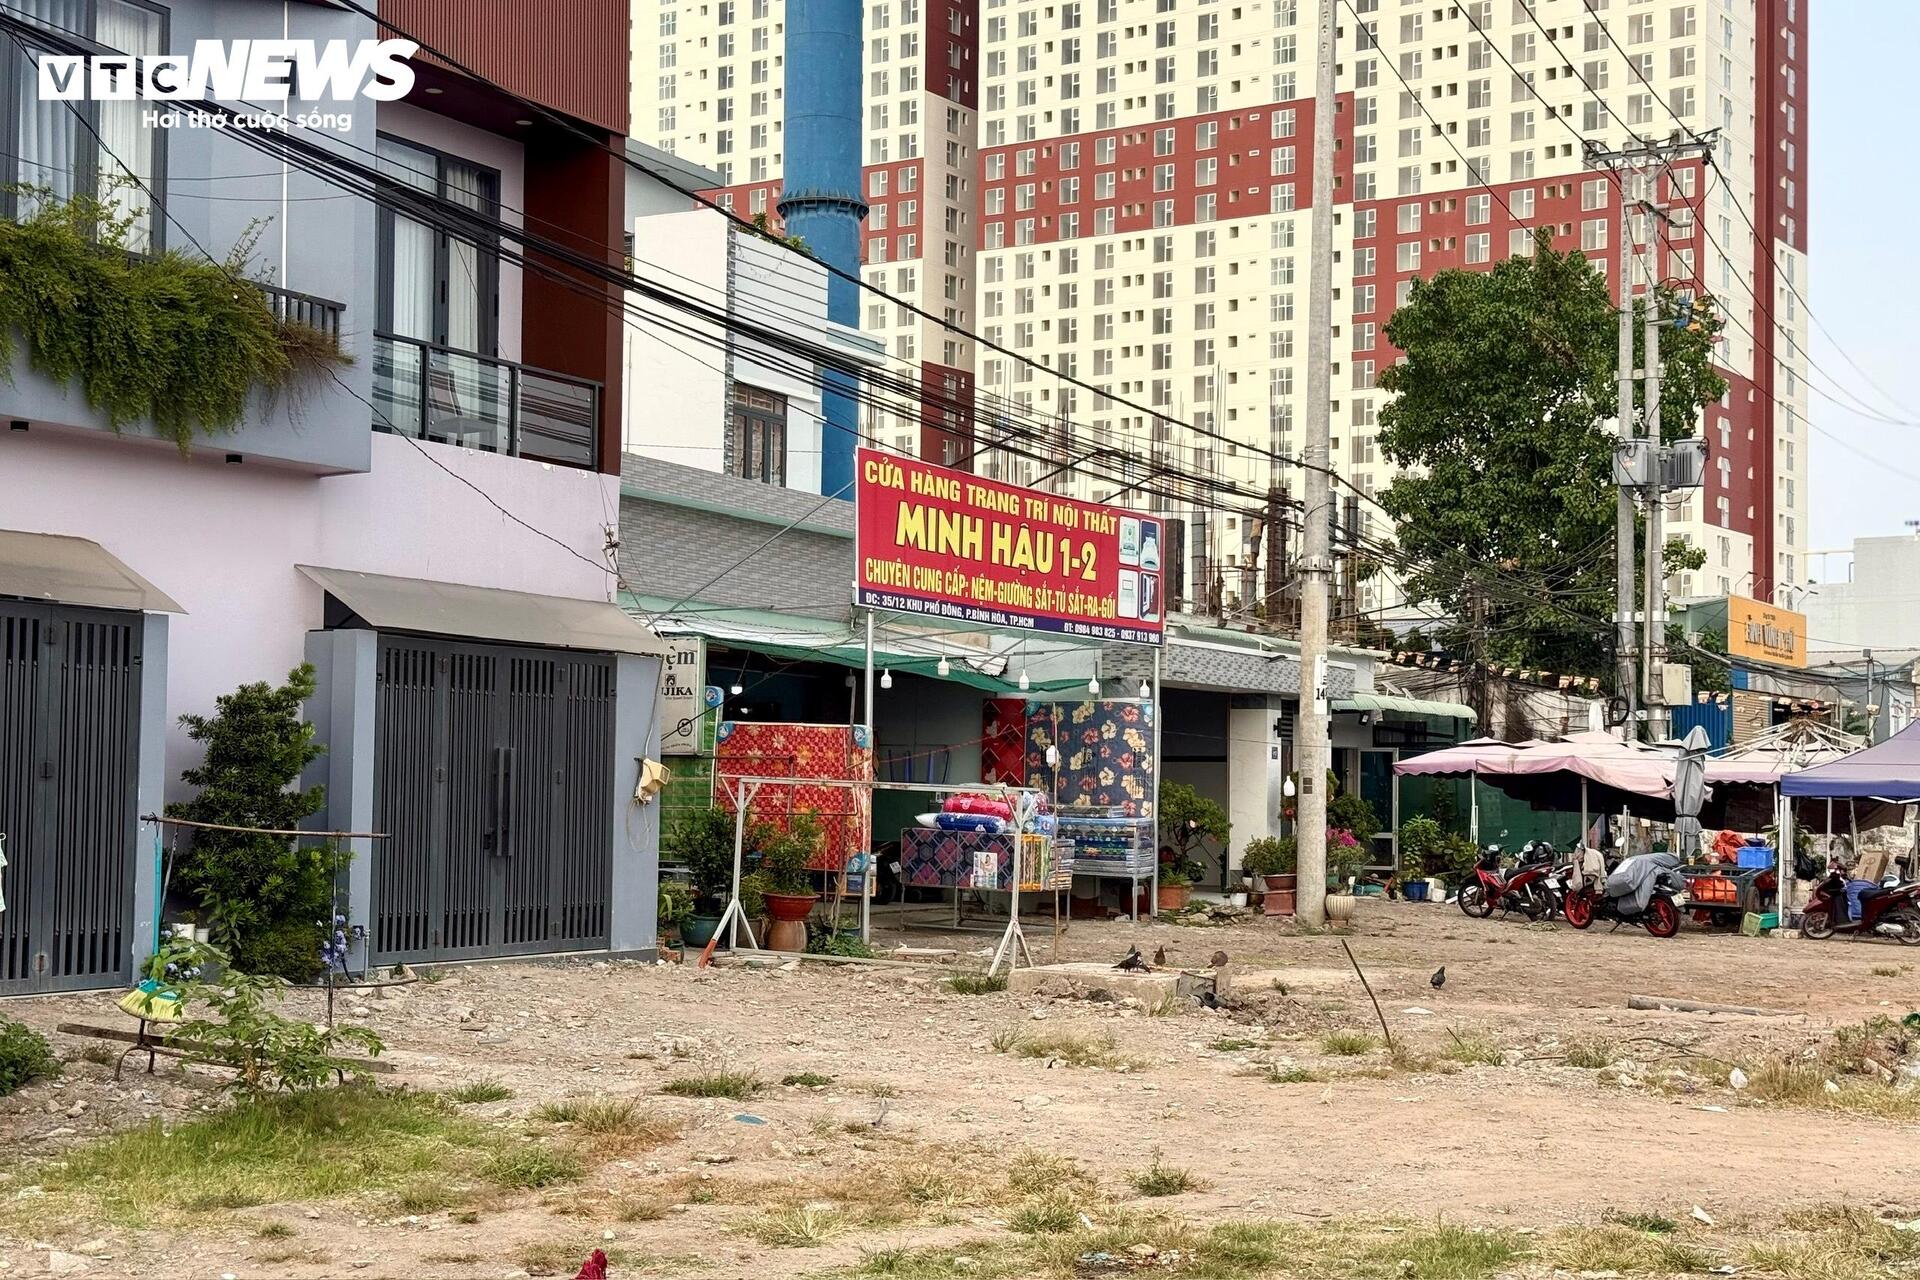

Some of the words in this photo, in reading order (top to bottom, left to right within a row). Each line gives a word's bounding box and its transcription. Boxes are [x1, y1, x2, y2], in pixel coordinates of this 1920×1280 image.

[864, 457, 905, 490] CỬA
[911, 470, 961, 503] HÀNG
[966, 484, 1020, 517] TRANG
[1025, 498, 1049, 522] TRÍ
[1053, 503, 1079, 531] NỘI
[1083, 509, 1117, 536] THẤT
[895, 501, 984, 561] MINH
[991, 523, 1054, 575] HẬU
[1059, 538, 1097, 582] 1-2
[865, 557, 910, 588] CHUYÊN
[913, 566, 943, 593] CUNG
[945, 565, 969, 597] CẤP:
[865, 592, 880, 605] ĐC:
[881, 595, 906, 609] 35/12
[906, 598, 923, 612] KHU
[924, 599, 940, 613] PHỐ
[1009, 615, 1035, 628] TP.HCM
[661, 686, 693, 696] JIKA
[1315, 687, 1327, 700] 14
